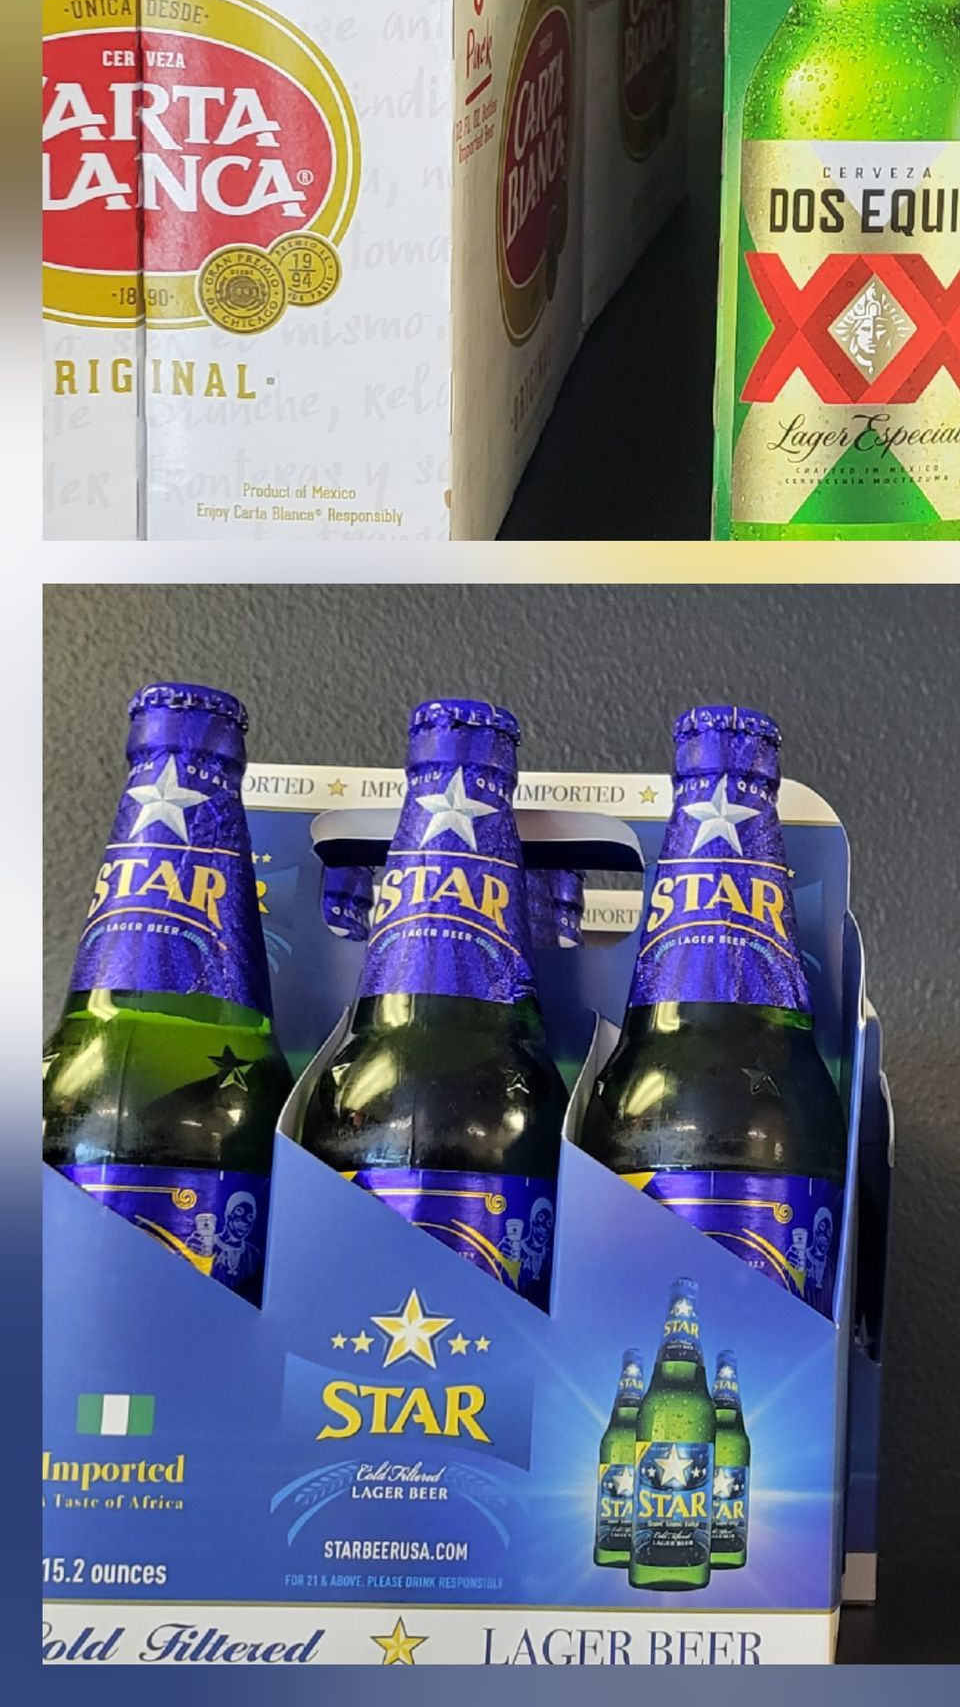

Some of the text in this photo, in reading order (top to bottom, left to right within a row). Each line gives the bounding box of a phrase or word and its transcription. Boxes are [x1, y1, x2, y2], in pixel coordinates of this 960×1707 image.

[466, 27, 492, 81] Pack
[42, 76, 282, 150] ARTA
[513, 51, 565, 162] CARTA
[505, 116, 565, 250] BLANCA
[823, 166, 932, 180] CERVEZA
[769, 188, 845, 233] DOS
[768, 414, 856, 462] Lager
[243, 483, 356, 500] Product of Mexico
[87, 857, 227, 930] STAR
[375, 864, 510, 934] STAR
[647, 873, 788, 941] STAR
[106, 922, 180, 936] LAGER BEER
[402, 927, 475, 943] LAGER BEER
[678, 935, 746, 948] LAGER BEER
[663, 1319, 699, 1338] STAR
[316, 1381, 493, 1445] STAR
[356, 1461, 445, 1483] Cold Filtered
[352, 1485, 448, 1501] LAGER BEER
[637, 1491, 707, 1518] STAR
[324, 1540, 468, 1562] STARBEERUSA.COM
[43, 1558, 167, 1584] 15.2 ounces
[285, 1574, 304, 1587] FOR
[306, 1574, 319, 1587] 21
[367, 1575, 403, 1589] PLEASE
[406, 1576, 435, 1589] DRINK
[438, 1576, 503, 1589] RESPONSIBLY
[482, 1627, 762, 1665] LAGER BEER
